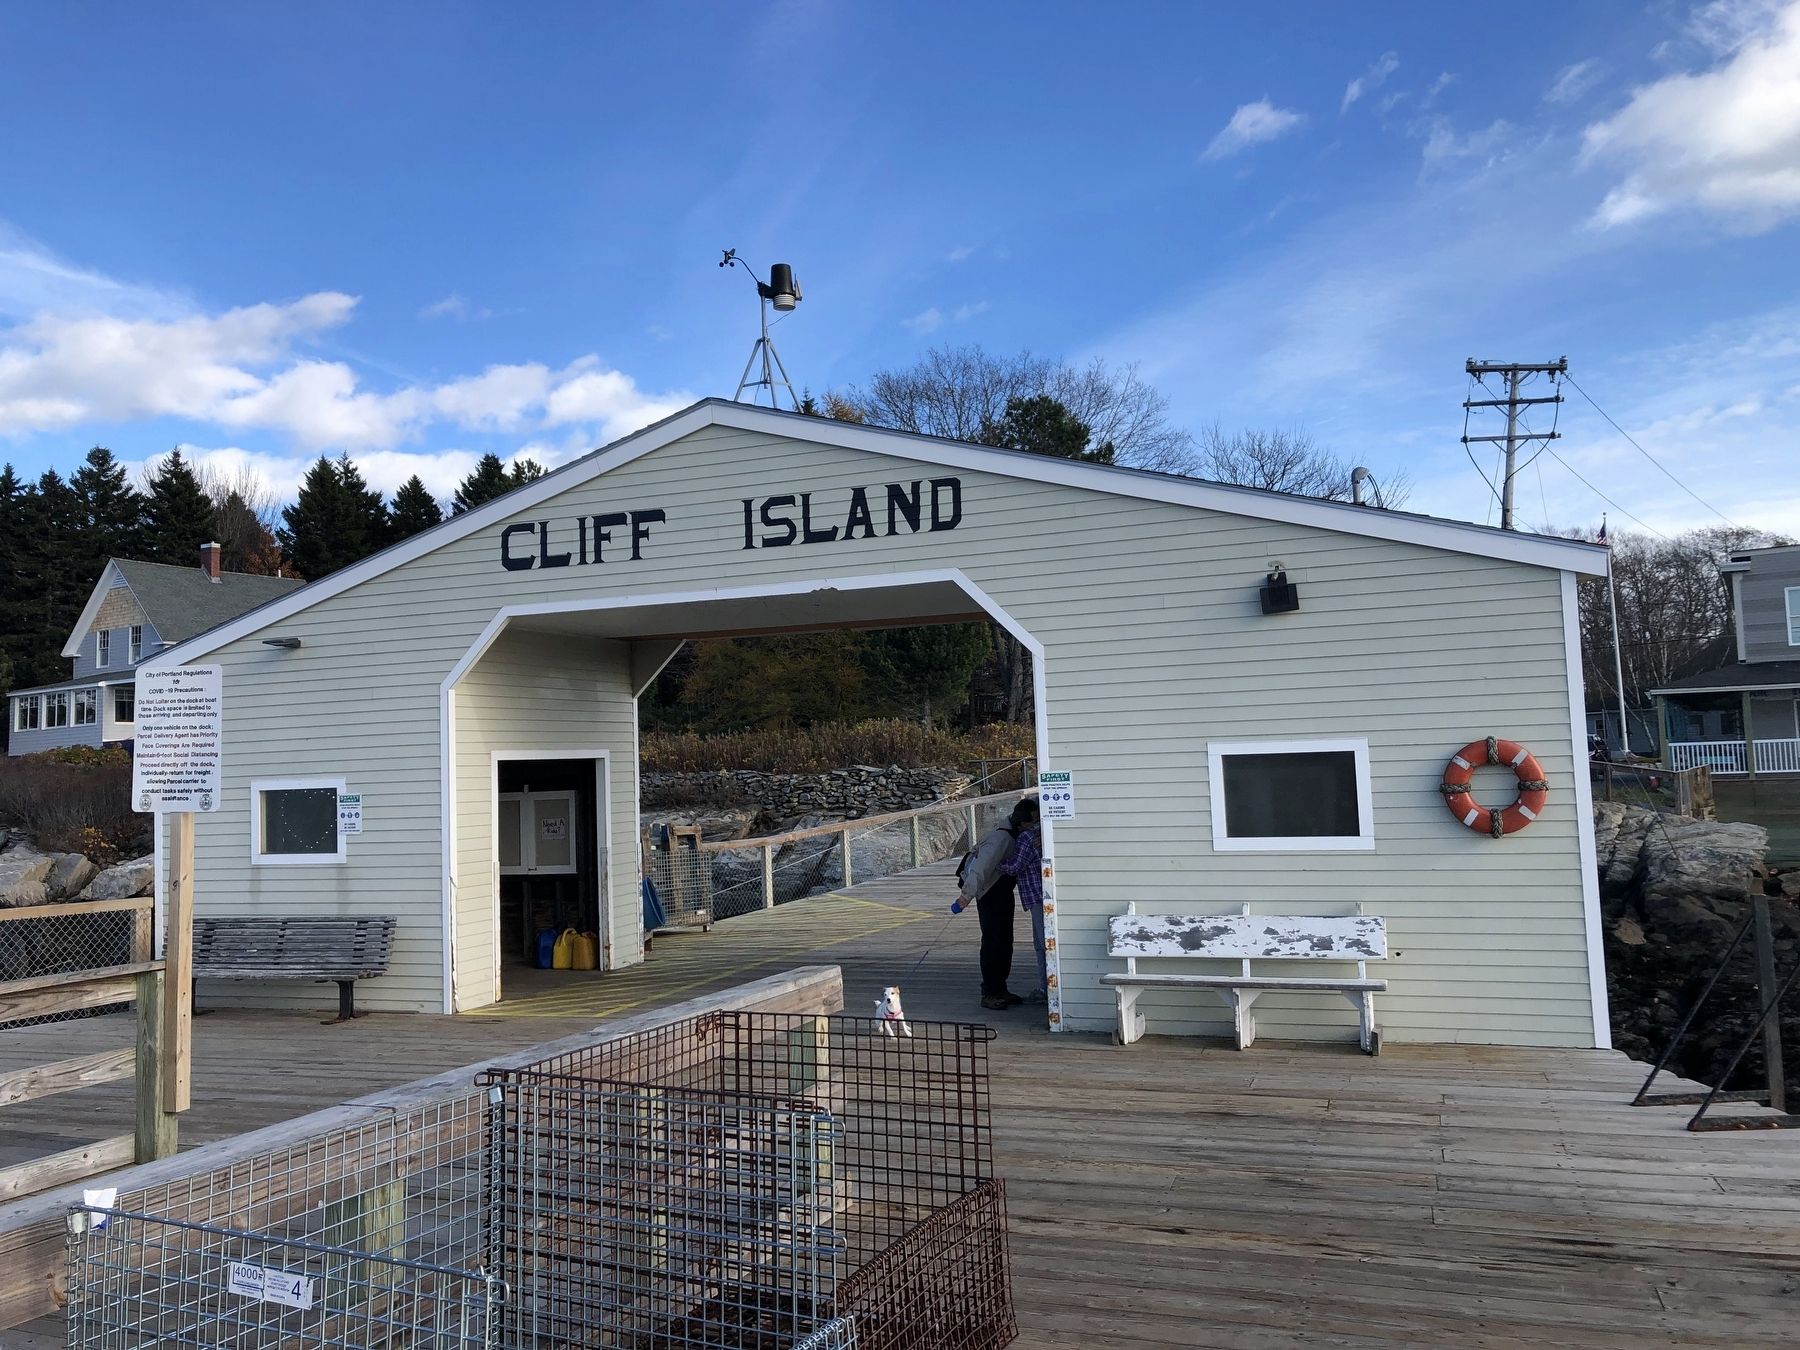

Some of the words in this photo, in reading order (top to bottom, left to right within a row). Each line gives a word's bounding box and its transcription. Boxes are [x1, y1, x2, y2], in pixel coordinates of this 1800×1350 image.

[500, 508, 666, 571] CLIFF
[741, 476, 962, 550] ISLAND
[291, 1280, 301, 1300] 4
